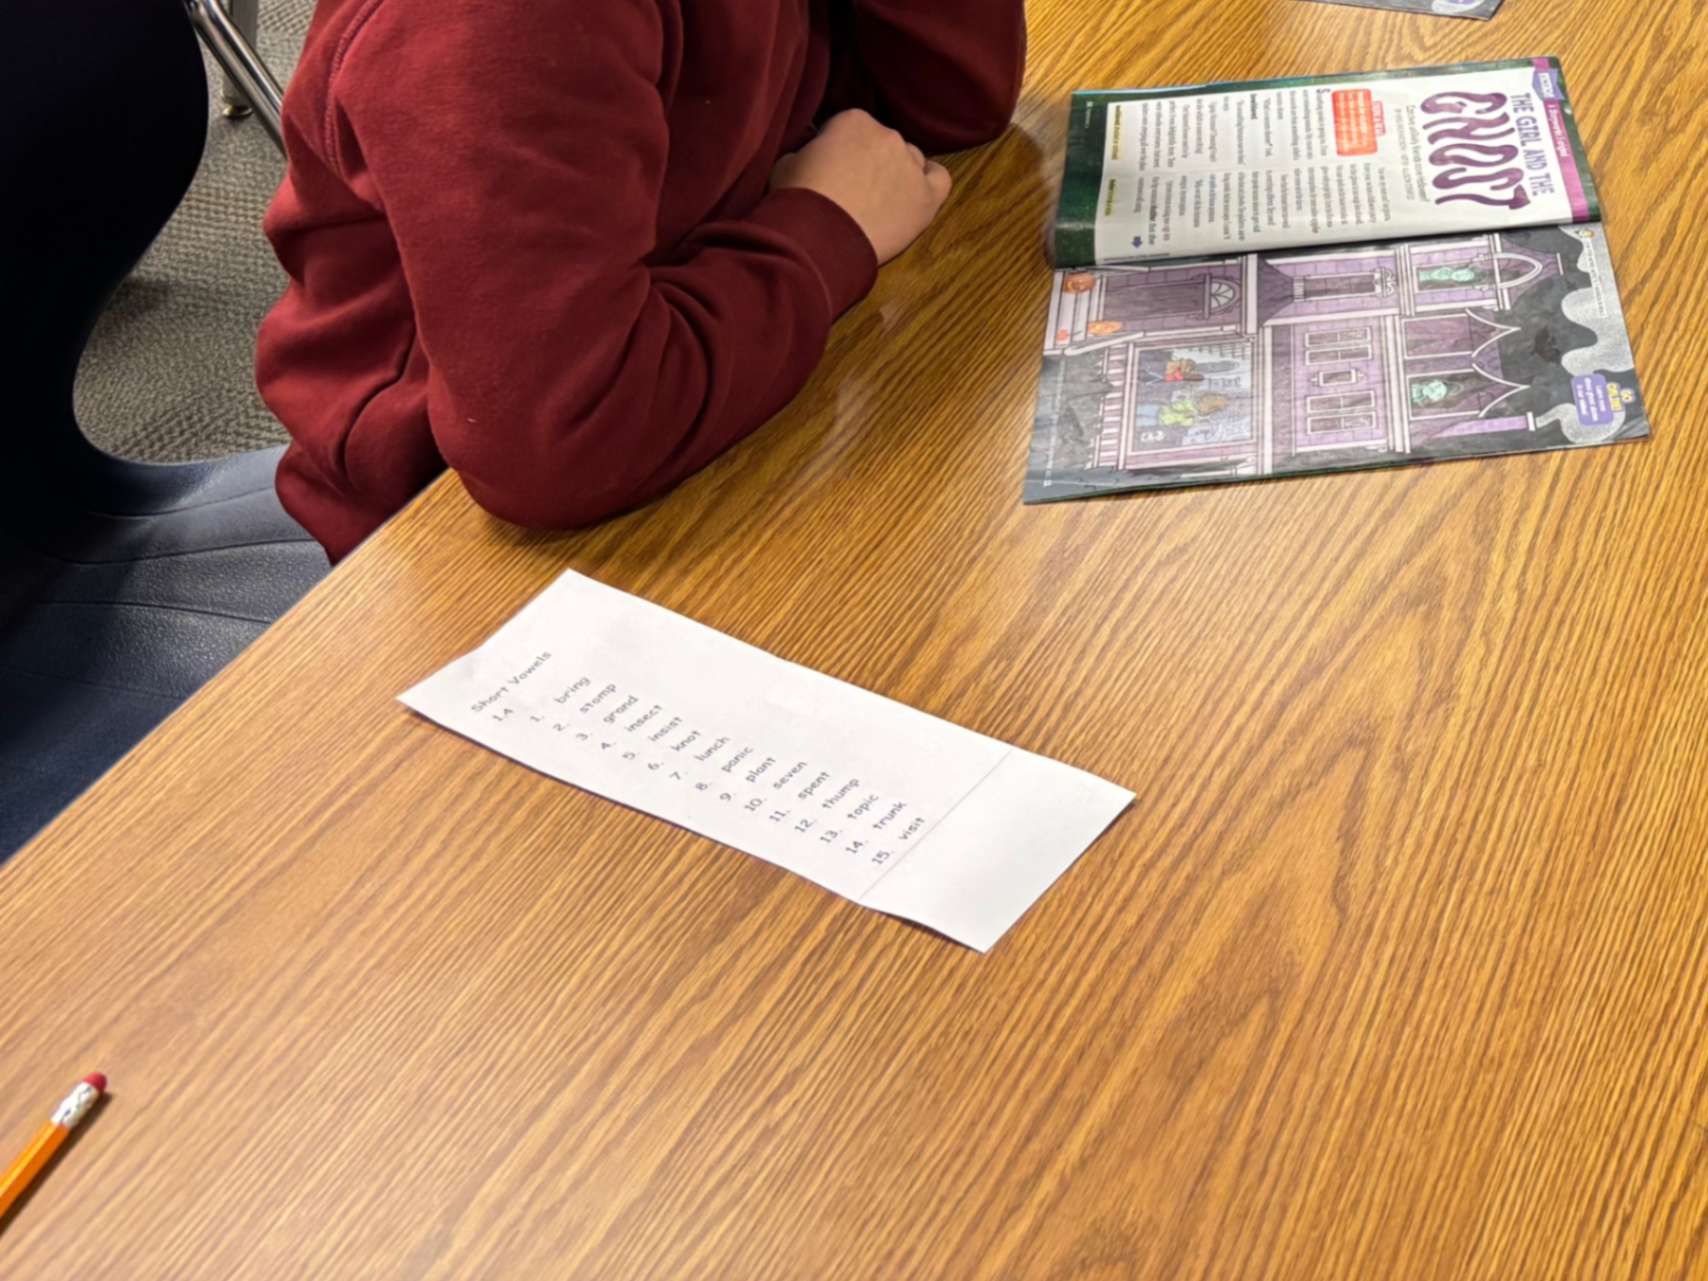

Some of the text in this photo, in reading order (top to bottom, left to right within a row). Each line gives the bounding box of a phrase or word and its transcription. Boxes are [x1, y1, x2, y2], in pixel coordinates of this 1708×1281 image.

[1511, 92, 1554, 195] THE GIRL AND THE
[471, 651, 552, 713] Short Vowels
[554, 676, 591, 704] bring
[579, 683, 617, 713] stomp
[603, 695, 639, 724] grand
[627, 704, 663, 732] insect
[648, 716, 683, 742] insist
[670, 730, 702, 752] knot
[694, 735, 730, 761] lunch
[721, 745, 754, 773] panic
[745, 756, 777, 783] plant
[773, 761, 808, 790] seven
[798, 771, 831, 800] spent
[821, 777, 860, 810] thump
[847, 793, 880, 820] topic
[873, 801, 907, 830] trunk
[898, 816, 926, 841] visit
